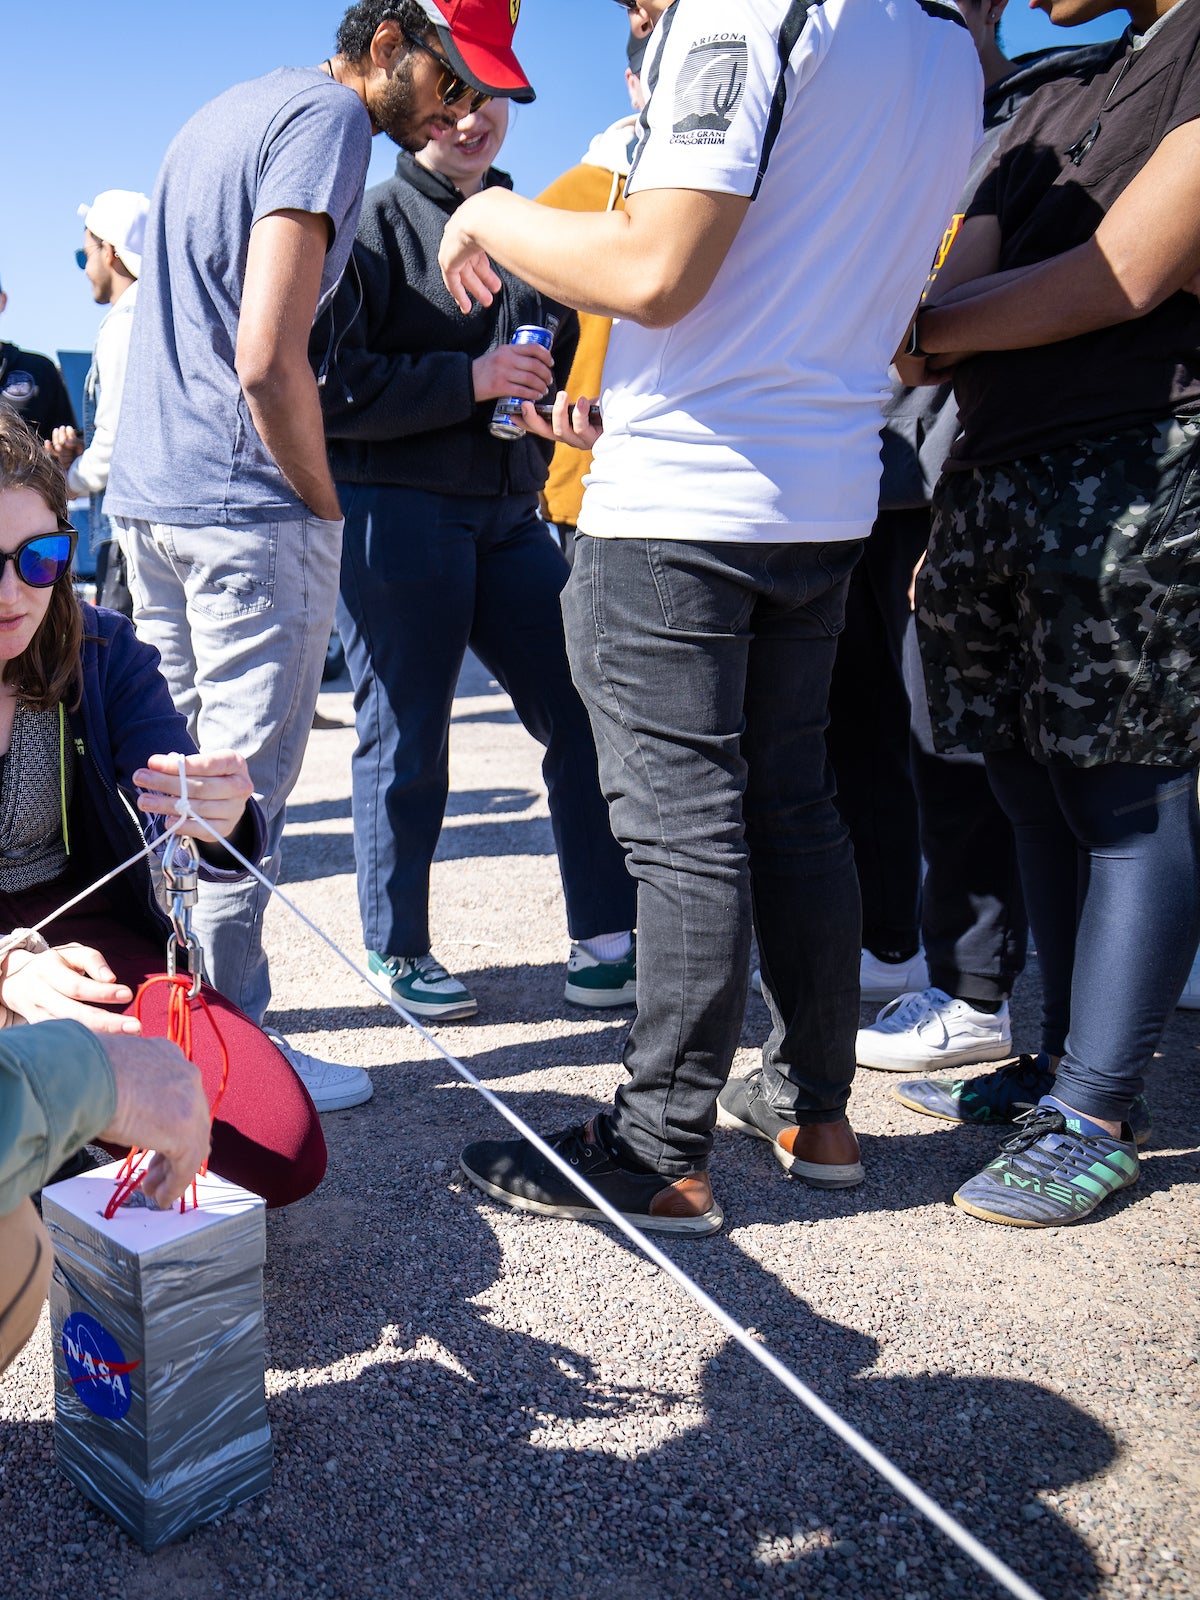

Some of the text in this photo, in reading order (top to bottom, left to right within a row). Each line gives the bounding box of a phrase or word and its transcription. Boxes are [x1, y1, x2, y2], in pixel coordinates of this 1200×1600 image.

[691, 33, 746, 48] ARIZONA
[669, 137, 726, 145] CONSORTIUM
[672, 130, 726, 140] SPACE GRANT
[67, 1337, 127, 1399] NASA
